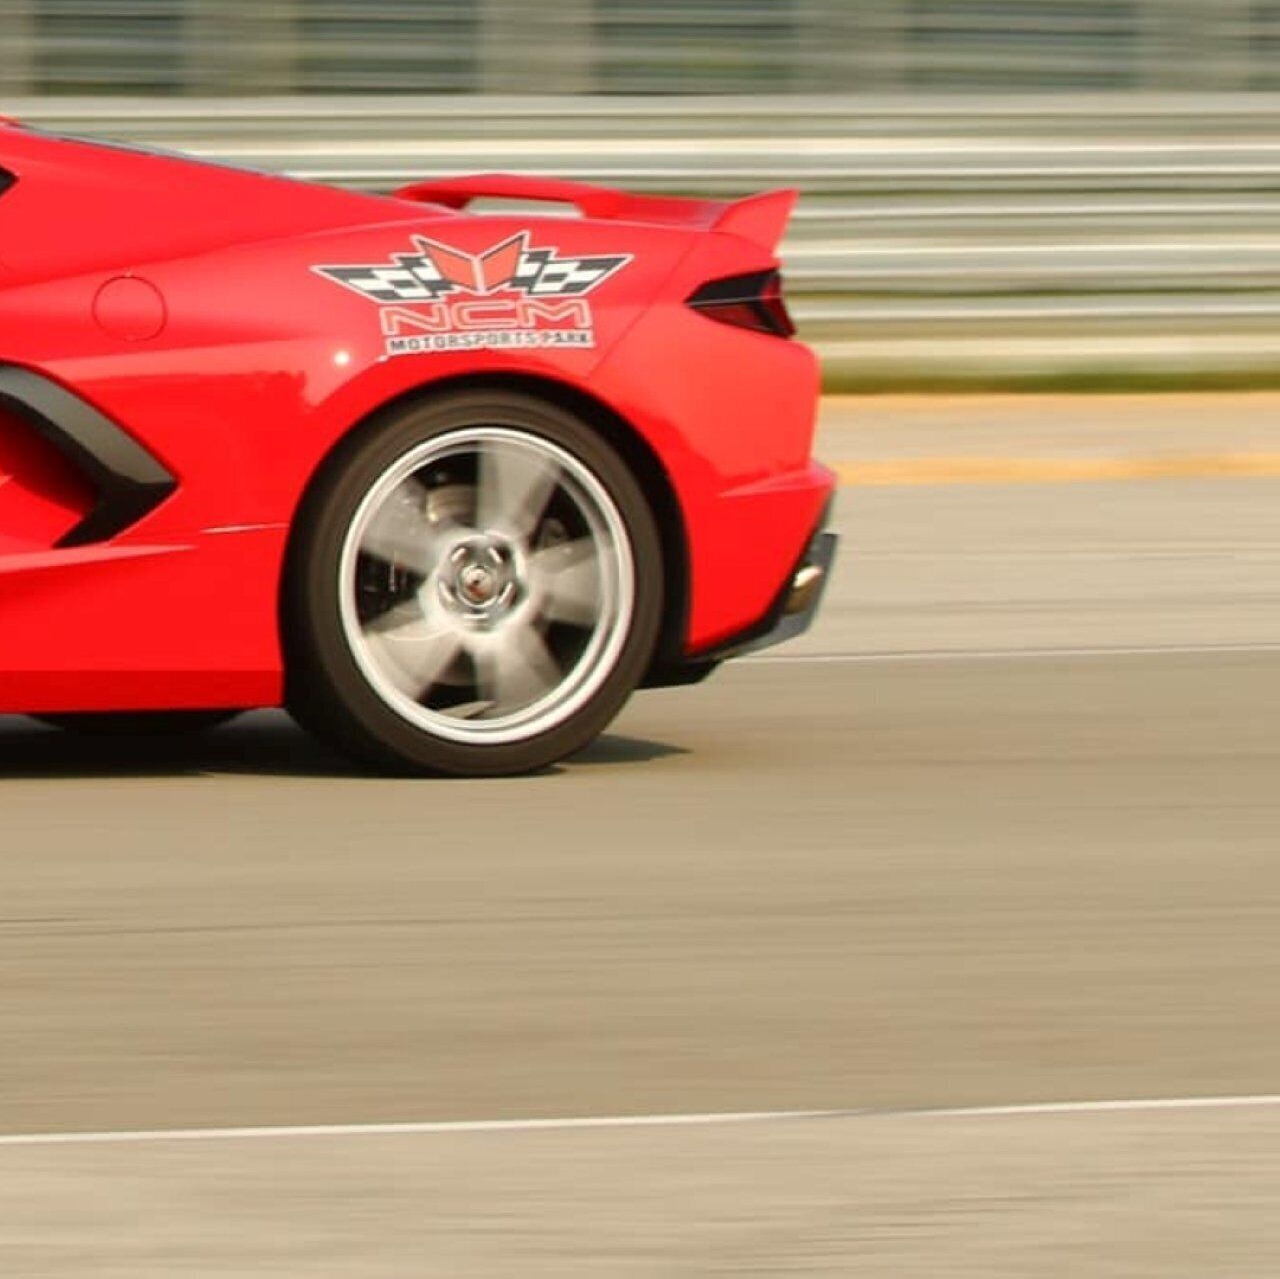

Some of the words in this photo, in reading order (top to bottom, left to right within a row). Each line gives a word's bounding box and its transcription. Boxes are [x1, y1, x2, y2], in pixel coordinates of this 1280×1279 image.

[380, 299, 593, 335] NCM
[389, 333, 537, 352] MOTORSPORTS
[541, 332, 589, 345] PARK
